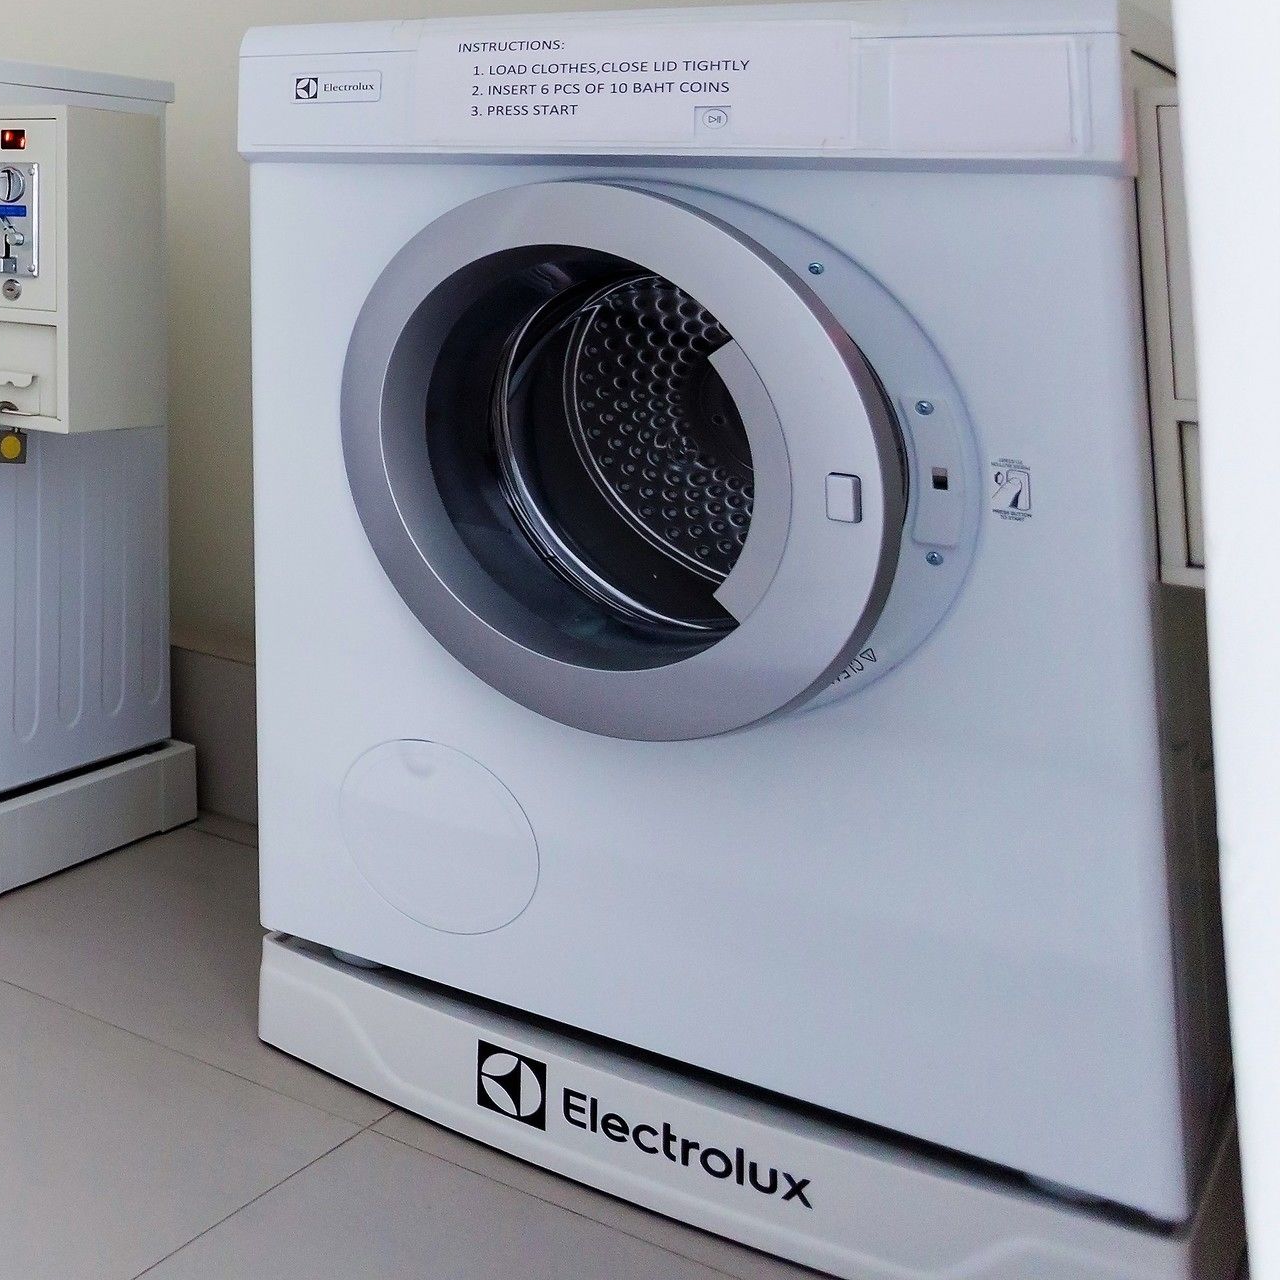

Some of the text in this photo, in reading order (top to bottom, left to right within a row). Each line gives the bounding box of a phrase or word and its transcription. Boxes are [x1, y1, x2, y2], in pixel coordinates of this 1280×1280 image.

[458, 40, 565, 52] INSTRUCTIONS:
[474, 66, 484, 75] 1.
[489, 65, 527, 75] LOAD
[654, 62, 677, 72] LID
[683, 60, 750, 71] TIGHTLY
[323, 82, 375, 92] Electrolux
[472, 82, 730, 96] 2. INSERT 6 PCS OF 10 BAHT COINS
[471, 104, 578, 116] 3. PRESS START
[563, 1087, 813, 1209] Electrolux
